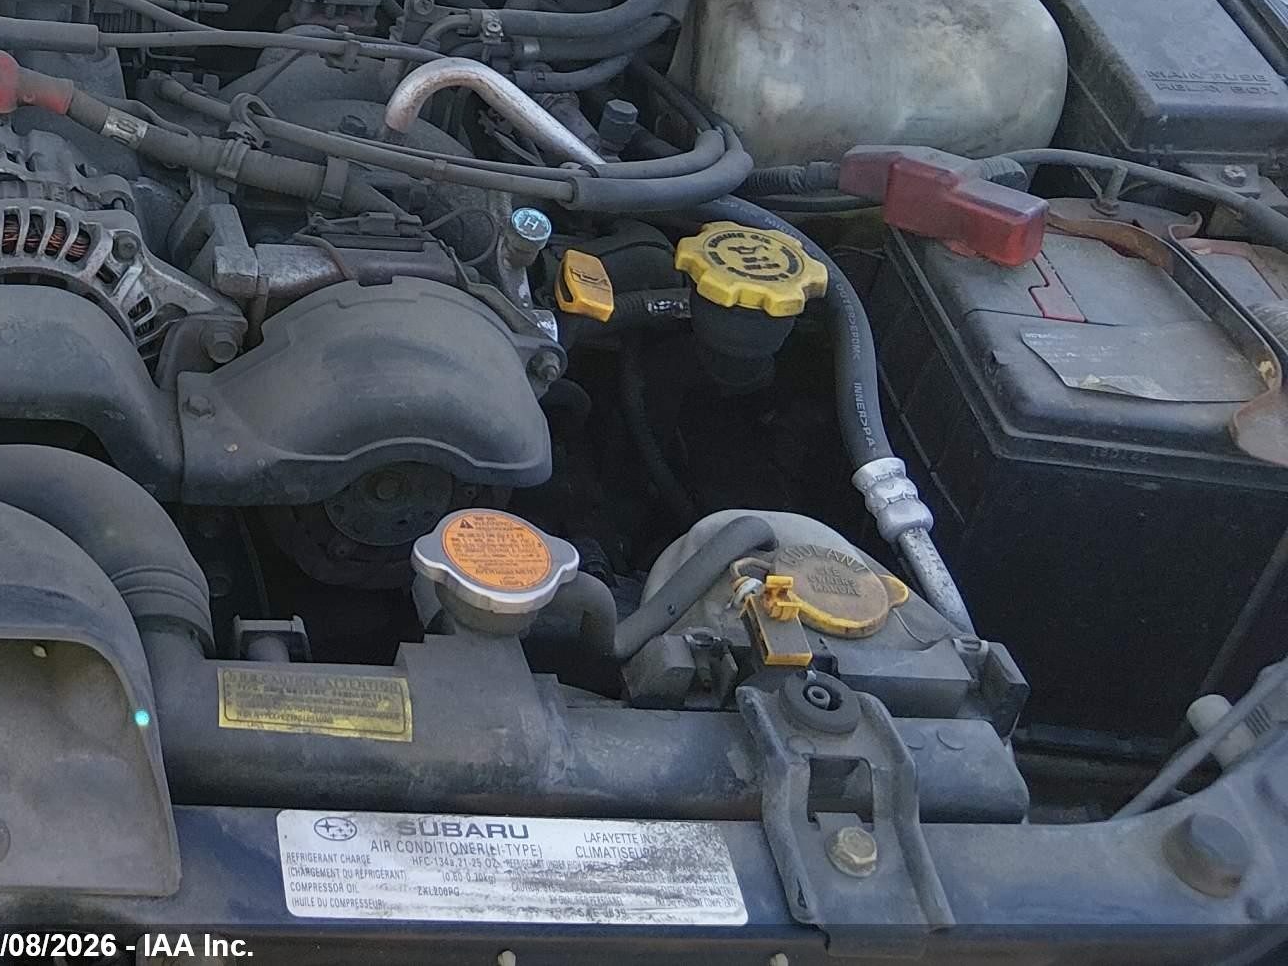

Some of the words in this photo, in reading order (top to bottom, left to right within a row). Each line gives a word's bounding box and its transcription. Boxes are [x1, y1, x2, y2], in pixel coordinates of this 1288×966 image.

[1212, 72, 1268, 83] FUSE
[523, 216, 539, 231] H
[396, 820, 529, 840] SUBARU
[584, 832, 639, 844] LAFAYETTE
[370, 839, 392, 853] AIR
[286, 852, 338, 864] REFRIGERANT
[341, 854, 372, 866] CHARGE
[288, 867, 341, 879] (CHARGEMENT
[290, 882, 344, 894] COMPRESSOR
[347, 883, 360, 894] OIL
[292, 897, 315, 909] (HUILE
[317, 898, 328, 909] DU
[330, 898, 386, 911] COMPRESSEUR)
